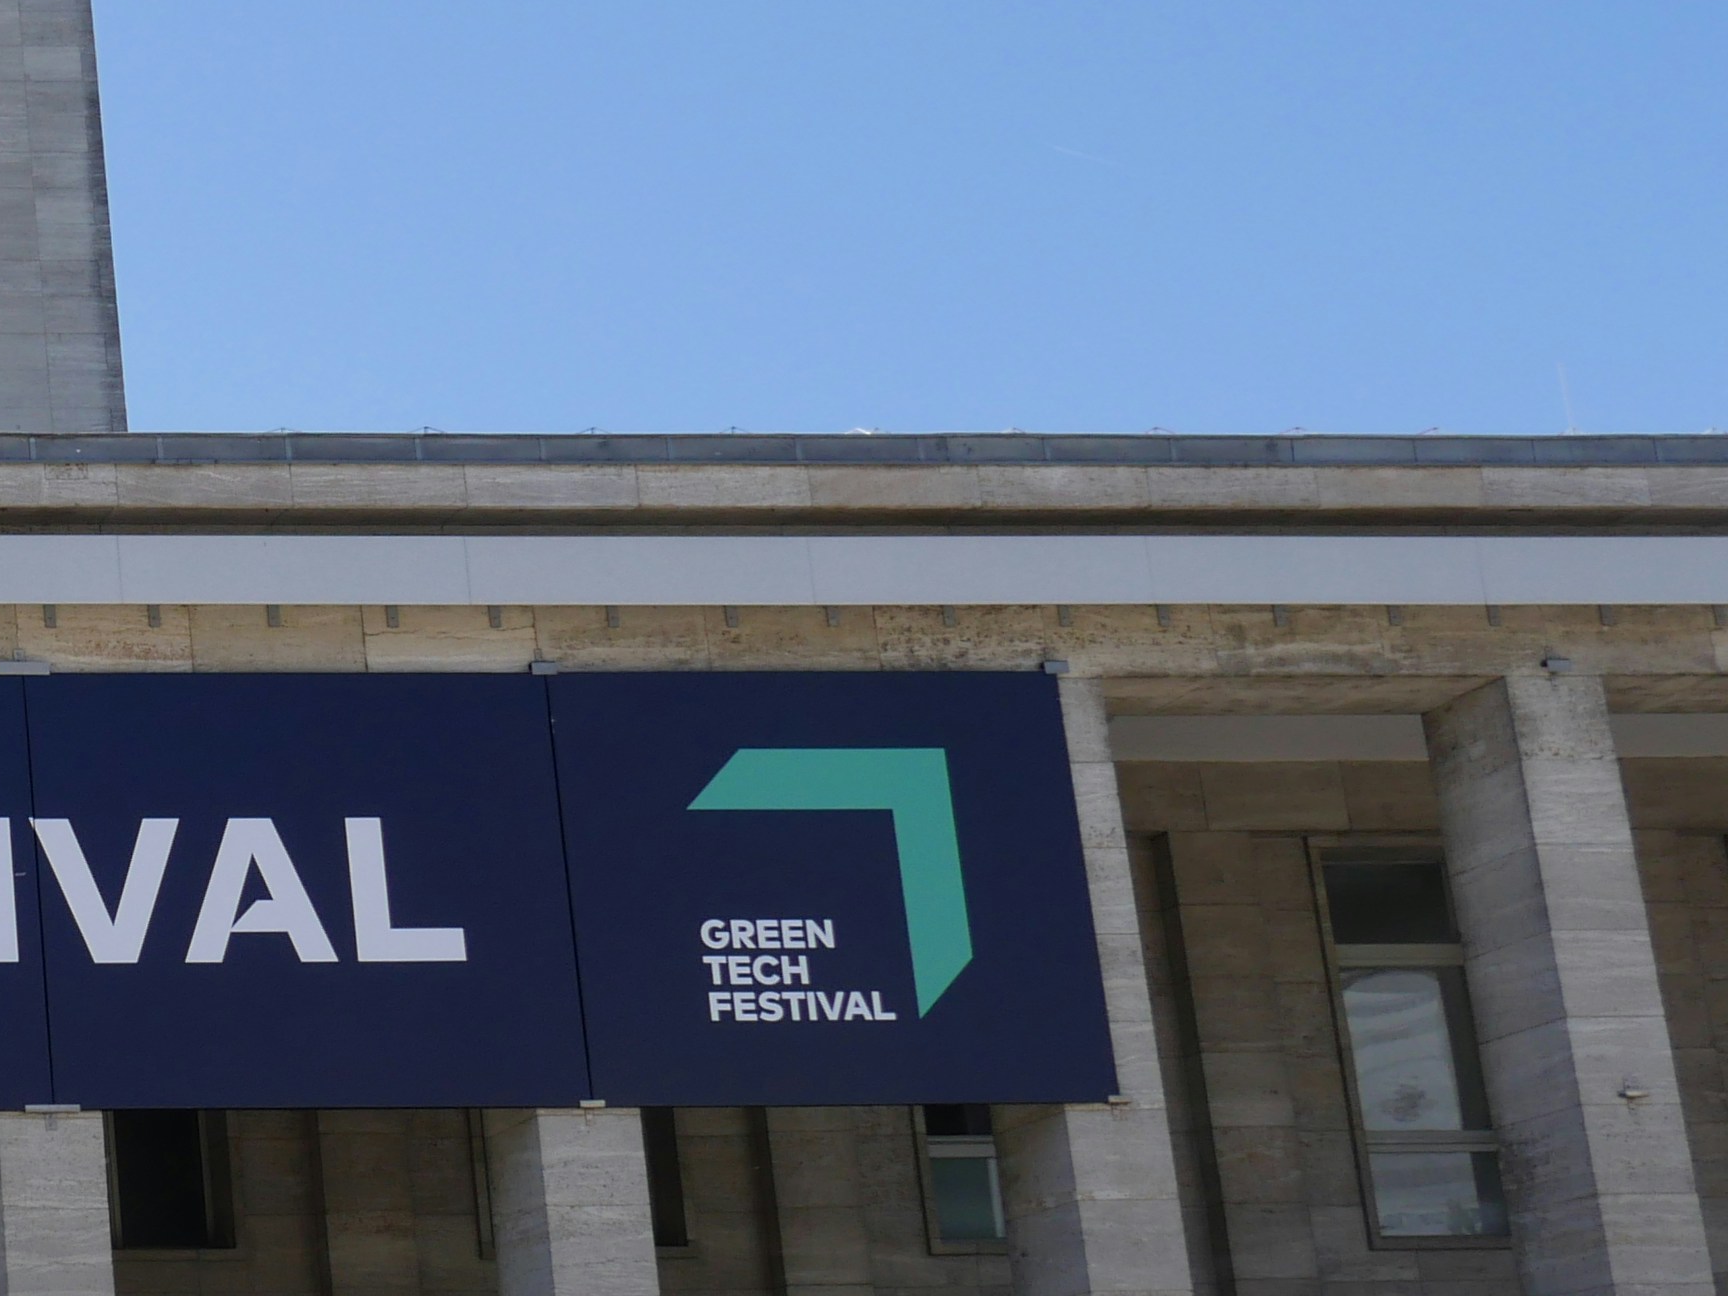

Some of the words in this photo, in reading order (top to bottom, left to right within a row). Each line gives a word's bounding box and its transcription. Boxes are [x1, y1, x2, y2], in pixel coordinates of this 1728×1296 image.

[700, 918, 836, 949] GREEN
[702, 955, 811, 985] TECH
[708, 990, 898, 1022] FESTIVAL
